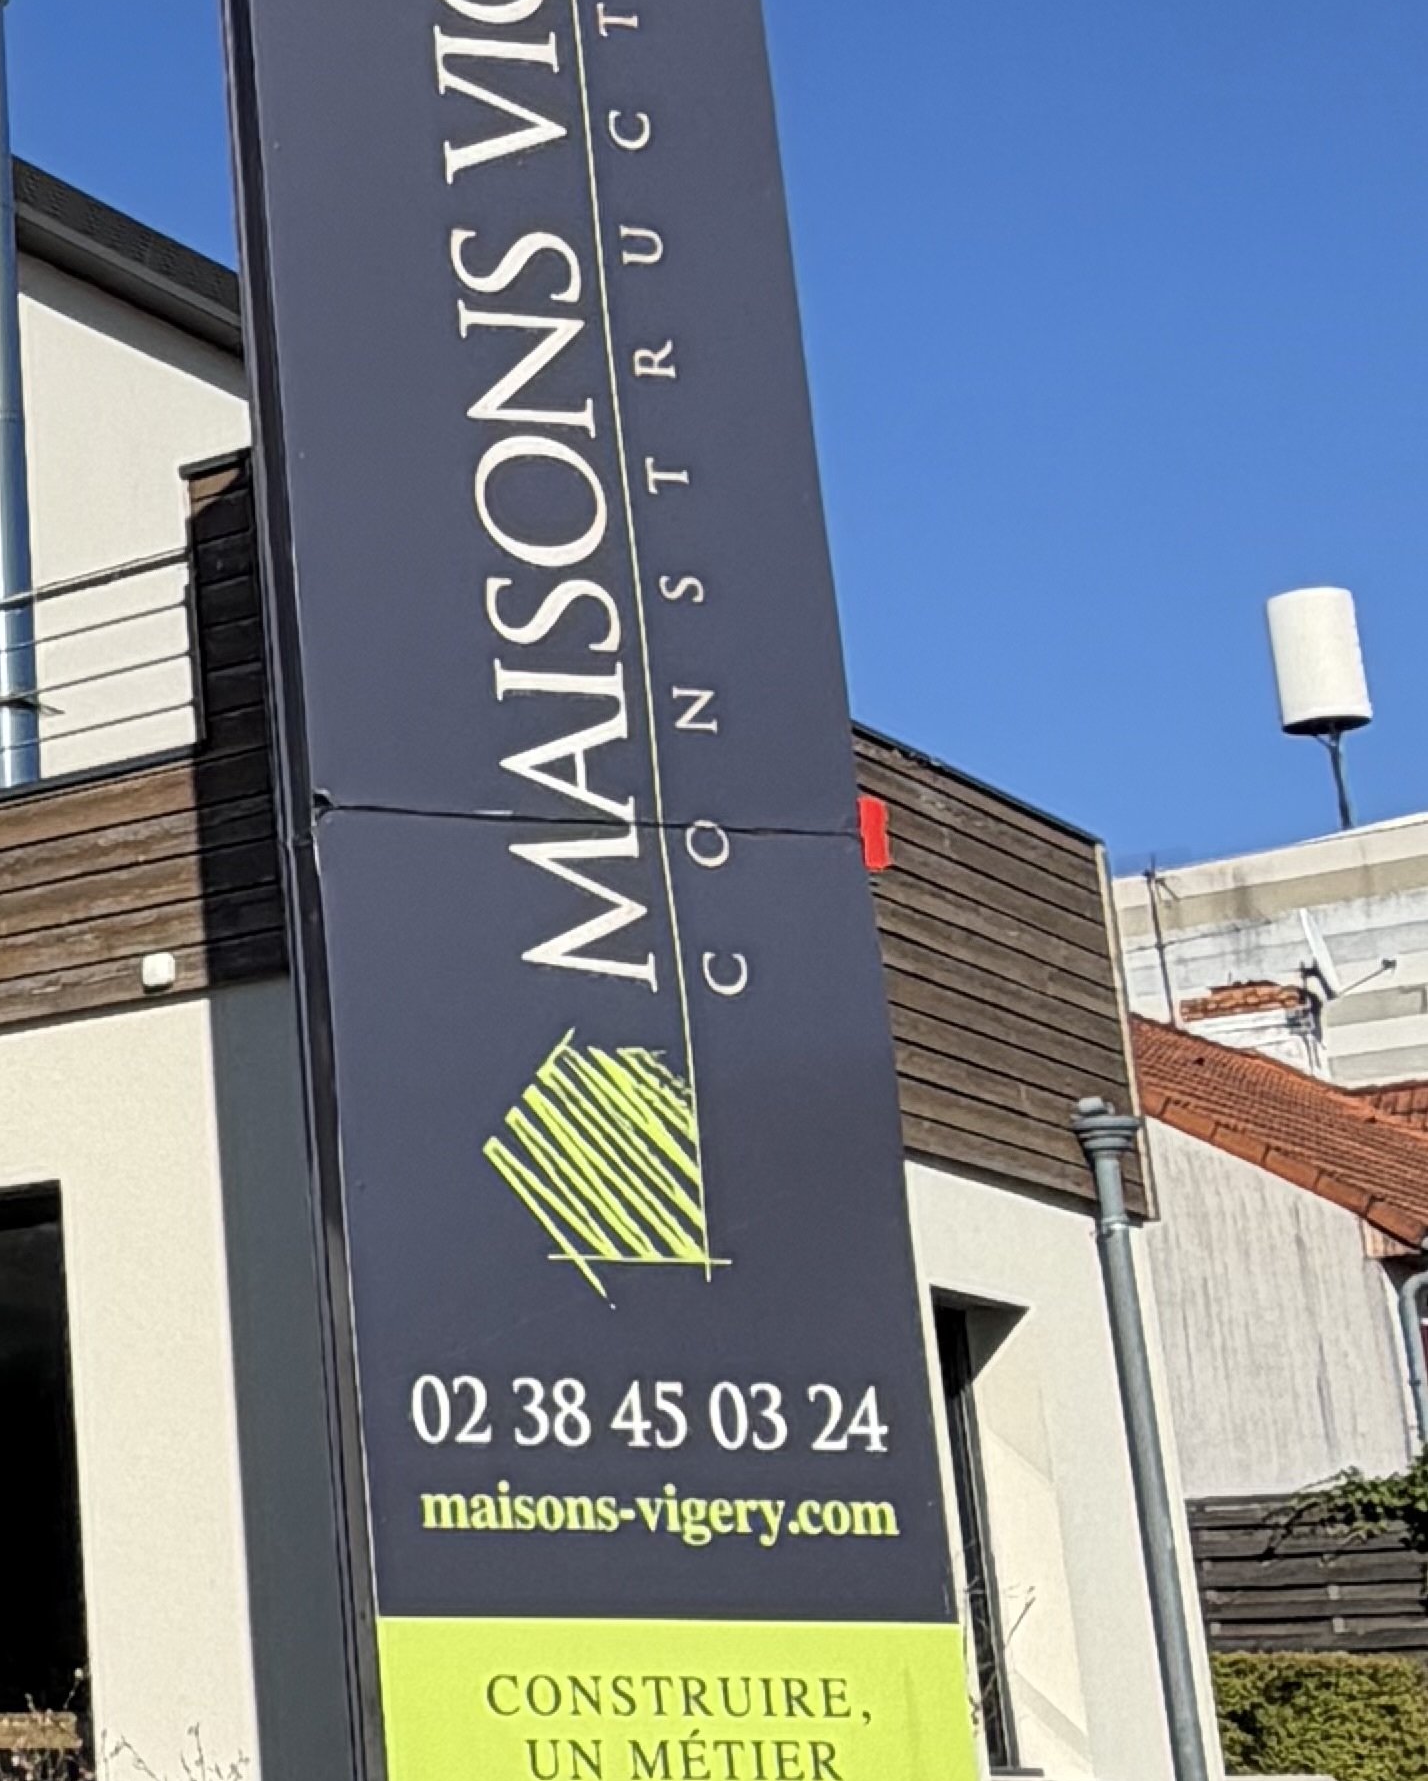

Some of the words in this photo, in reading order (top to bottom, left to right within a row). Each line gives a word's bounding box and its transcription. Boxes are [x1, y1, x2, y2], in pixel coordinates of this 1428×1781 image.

[450, 227, 659, 993] MAISONS
[412, 1375, 491, 1444] 02
[513, 1378, 591, 1446] 38
[611, 1380, 687, 1448] 45
[709, 1382, 787, 1450] 03
[808, 1384, 888, 1452] 24
[421, 1480, 899, 1546] maisons-vigery.com
[487, 1676, 871, 1724] CONSTRUIRE,
[527, 1740, 601, 1780] UN
[629, 1730, 842, 1781] MÉTIER
